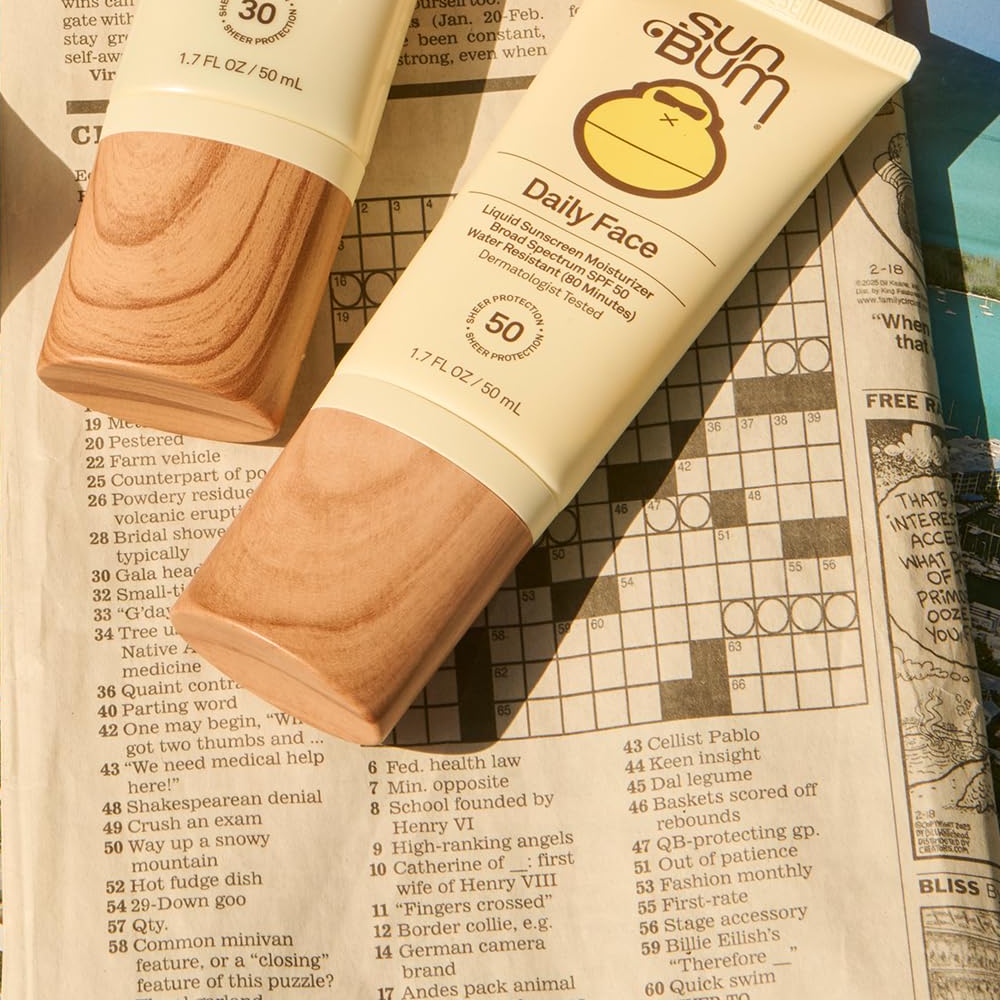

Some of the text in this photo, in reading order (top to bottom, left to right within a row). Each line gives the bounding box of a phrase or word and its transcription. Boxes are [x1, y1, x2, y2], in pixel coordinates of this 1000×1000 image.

[238, 0, 276, 24] 30
[223, 9, 296, 45] SHEER PROTECTION
[419, 26, 546, 46] been constant,
[179, 53, 303, 91] 1.7 FL OZ 50 mL
[523, 178, 658, 258] Daily Face
[483, 204, 654, 299] Liquid Sunscreen Moisturizer
[490, 222, 630, 299] Broad Spectrum SPF 50
[467, 227, 637, 322] Water Resistant (80 Minutes)
[870, 264, 904, 274] 2-18
[478, 249, 604, 320] Dermatologist Tested
[485, 312, 524, 342] 50
[896, 334, 929, 354] that
[410, 347, 521, 416] 1.7 FL OZ 50 mL
[866, 394, 919, 409] FREE
[707, 420, 722, 433] 36
[741, 418, 755, 430] 37
[807, 412, 822, 424] 39
[85, 434, 184, 450] 20 Pestered
[86, 450, 221, 469] 22 Farm vehicle
[97, 696, 237, 718] 40 Parting word
[625, 748, 761, 773] 44 Keen insight
[369, 775, 510, 795] 7 Min. opposite
[102, 790, 322, 815] 48 Shakespearean denial
[636, 864, 813, 894] 53 Fashion monthly
[919, 878, 980, 896] BLISS
[375, 938, 546, 959] 14 German camera
[402, 962, 456, 978] brand
